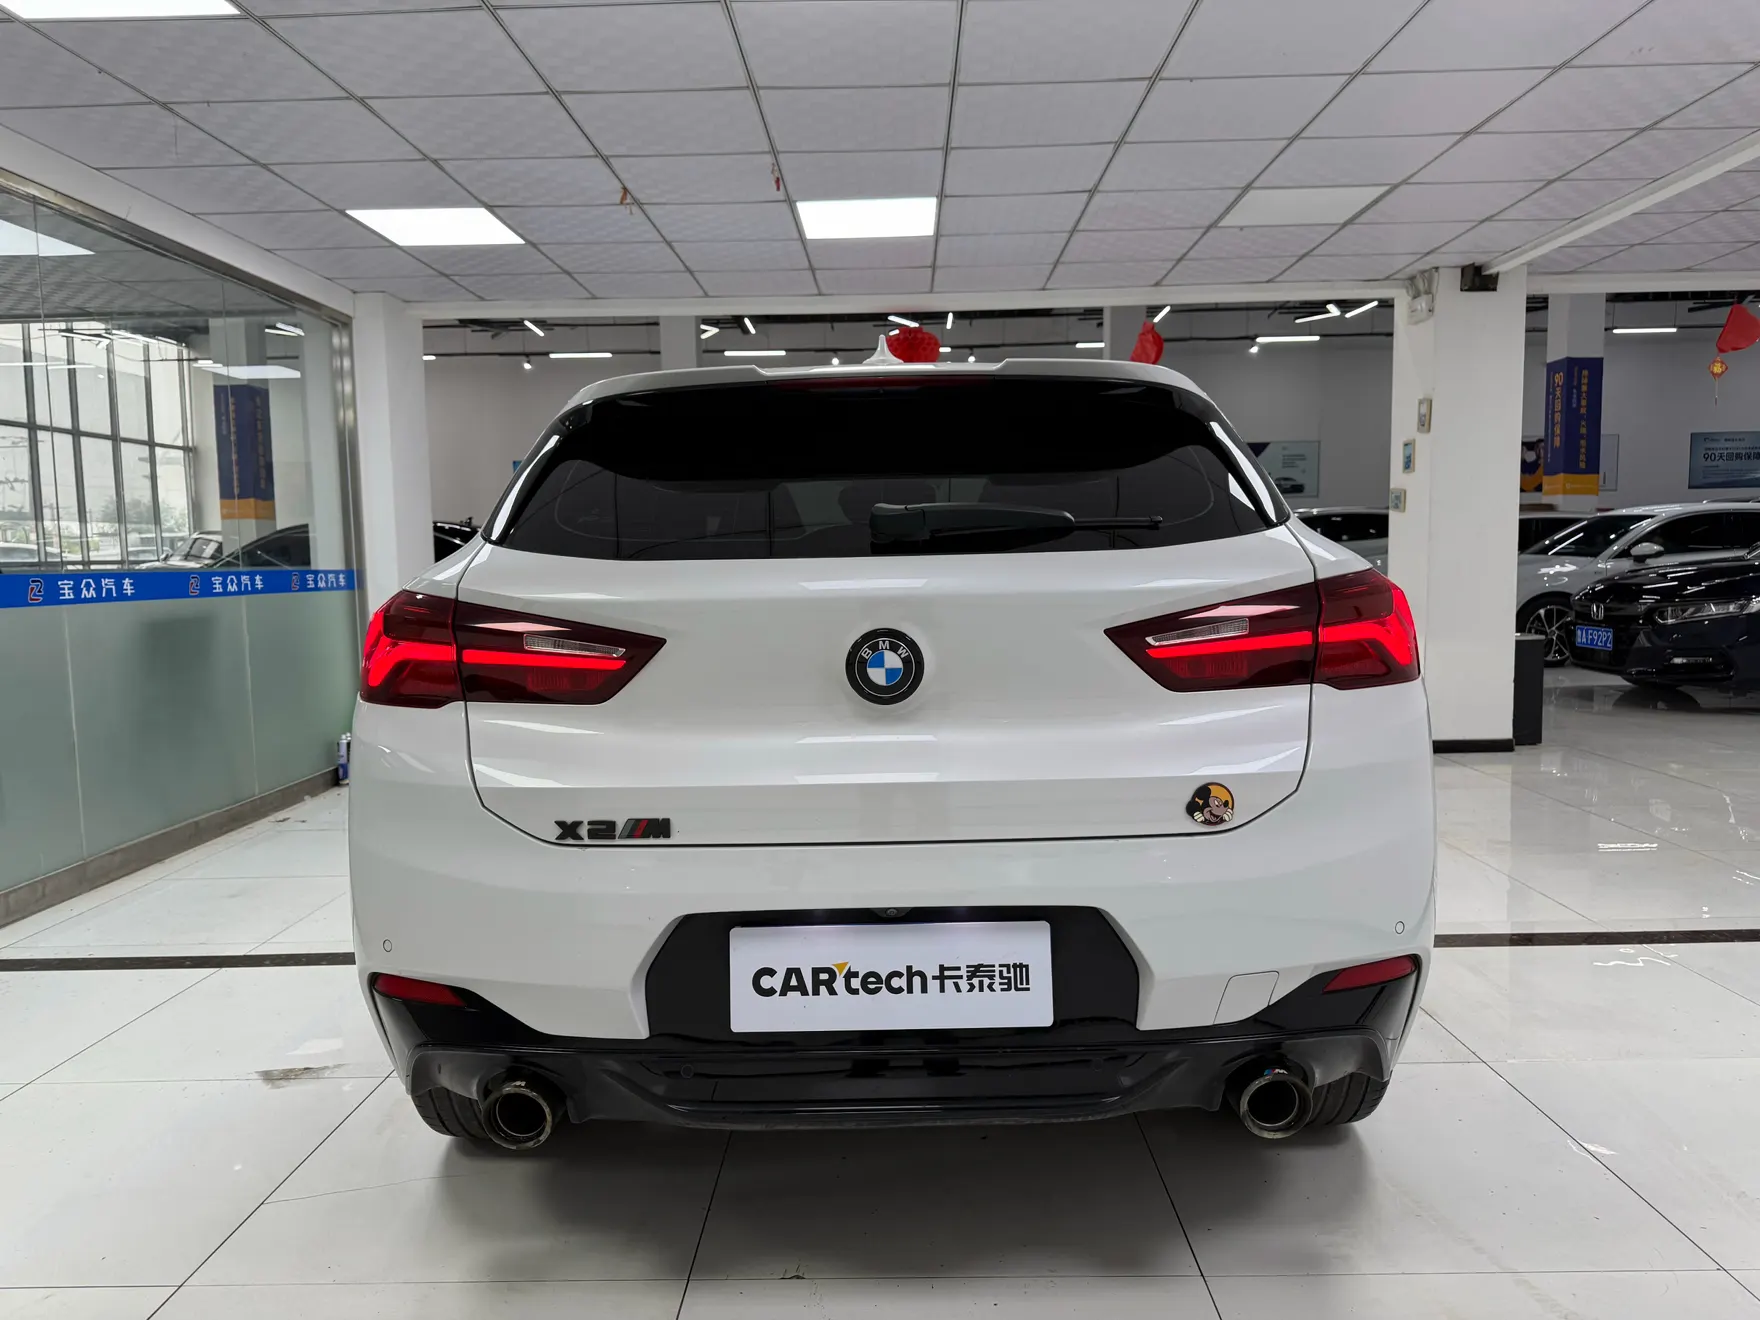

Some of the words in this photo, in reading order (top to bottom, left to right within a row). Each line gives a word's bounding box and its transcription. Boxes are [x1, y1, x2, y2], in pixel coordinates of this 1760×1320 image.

[57, 577, 136, 600] 宝众汽车
[211, 574, 265, 593] 宝众汽车
[306, 573, 347, 589] 宝众汽车
[860, 640, 909, 660] BMW
[554, 819, 616, 841] X2
[751, 963, 928, 998] CARtech
[932, 962, 1031, 994] 卡泰驰
